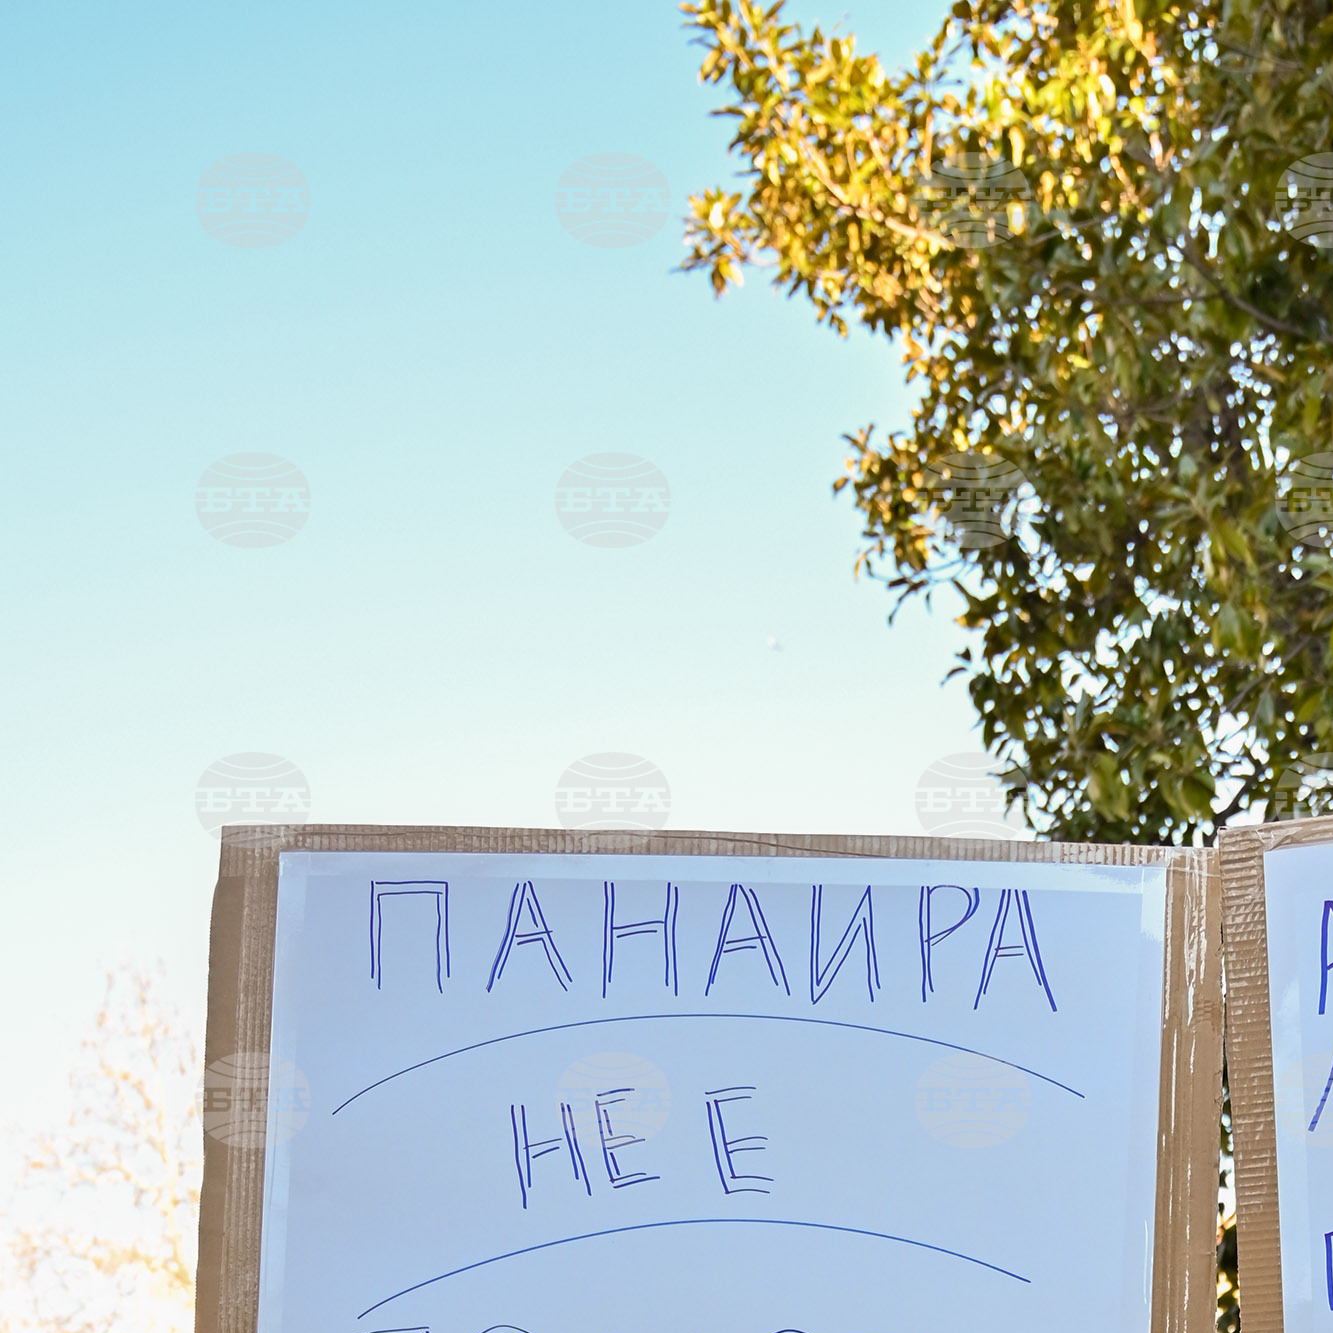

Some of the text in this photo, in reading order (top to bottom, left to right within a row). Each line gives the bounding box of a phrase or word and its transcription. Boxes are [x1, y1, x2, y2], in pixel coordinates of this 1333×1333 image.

[369, 880, 1057, 1012] ПАНАИРА
[510, 1086, 774, 1208] НЕ Е
